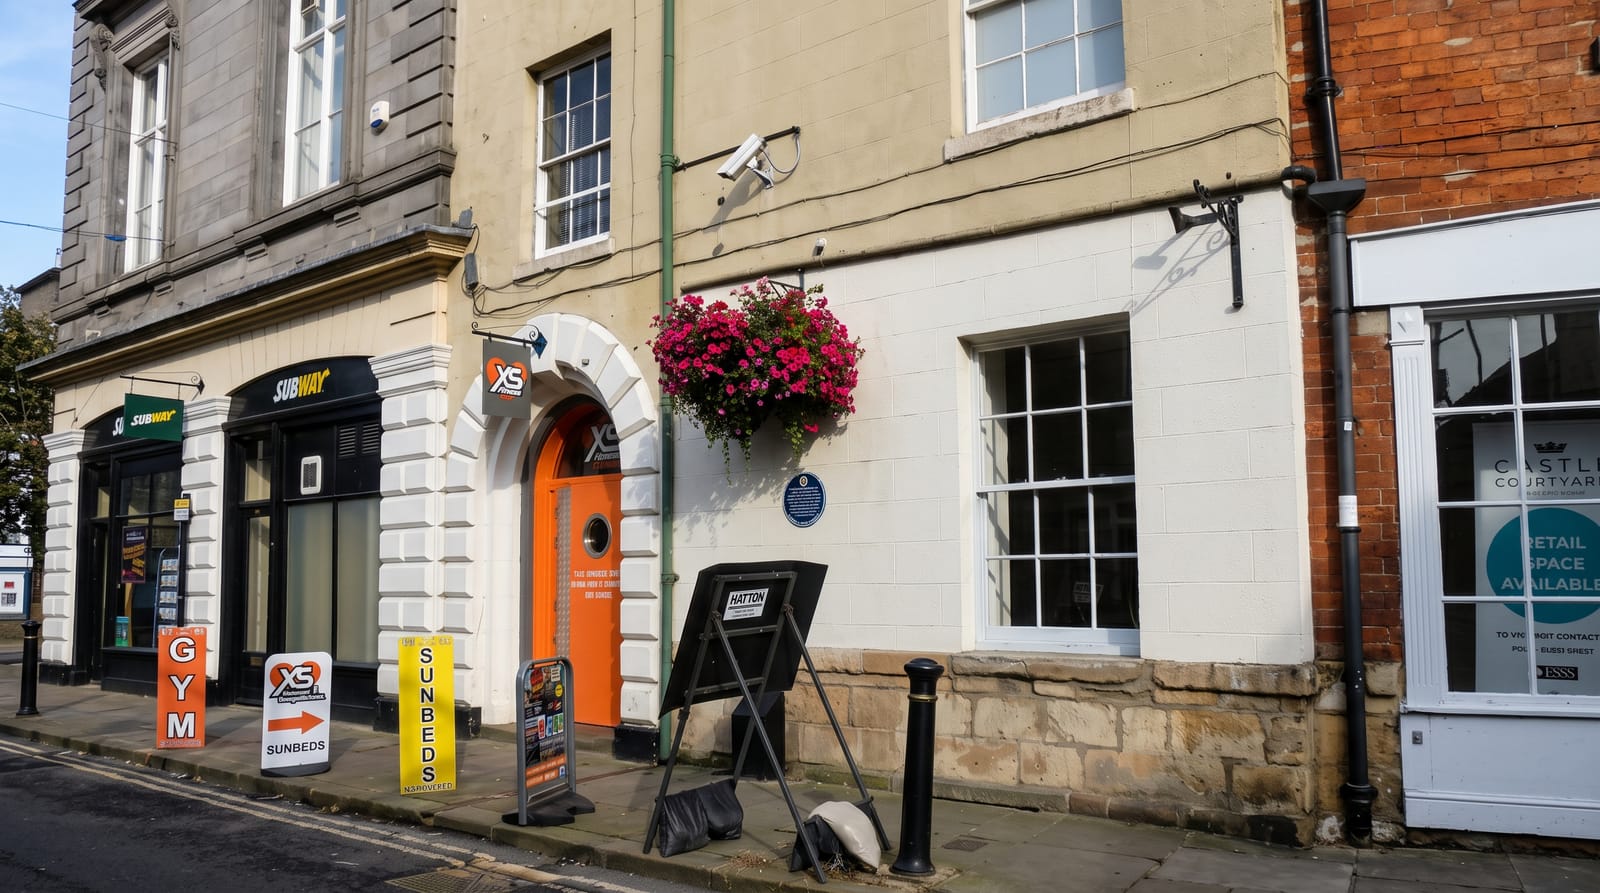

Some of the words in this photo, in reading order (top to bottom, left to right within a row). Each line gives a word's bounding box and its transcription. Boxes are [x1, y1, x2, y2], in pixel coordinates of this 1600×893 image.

[273, 368, 331, 404] SUBWAY
[490, 365, 524, 393] XS
[131, 409, 176, 426] SUBWAY
[730, 591, 766, 605] HATTON
[1496, 631, 1509, 639] TO
[1556, 633, 1600, 641] CONTACT
[167, 635, 197, 740] GYM
[271, 666, 314, 698] XS
[420, 647, 436, 783] SUNBEDS
[266, 741, 326, 756] SUNBEDS
